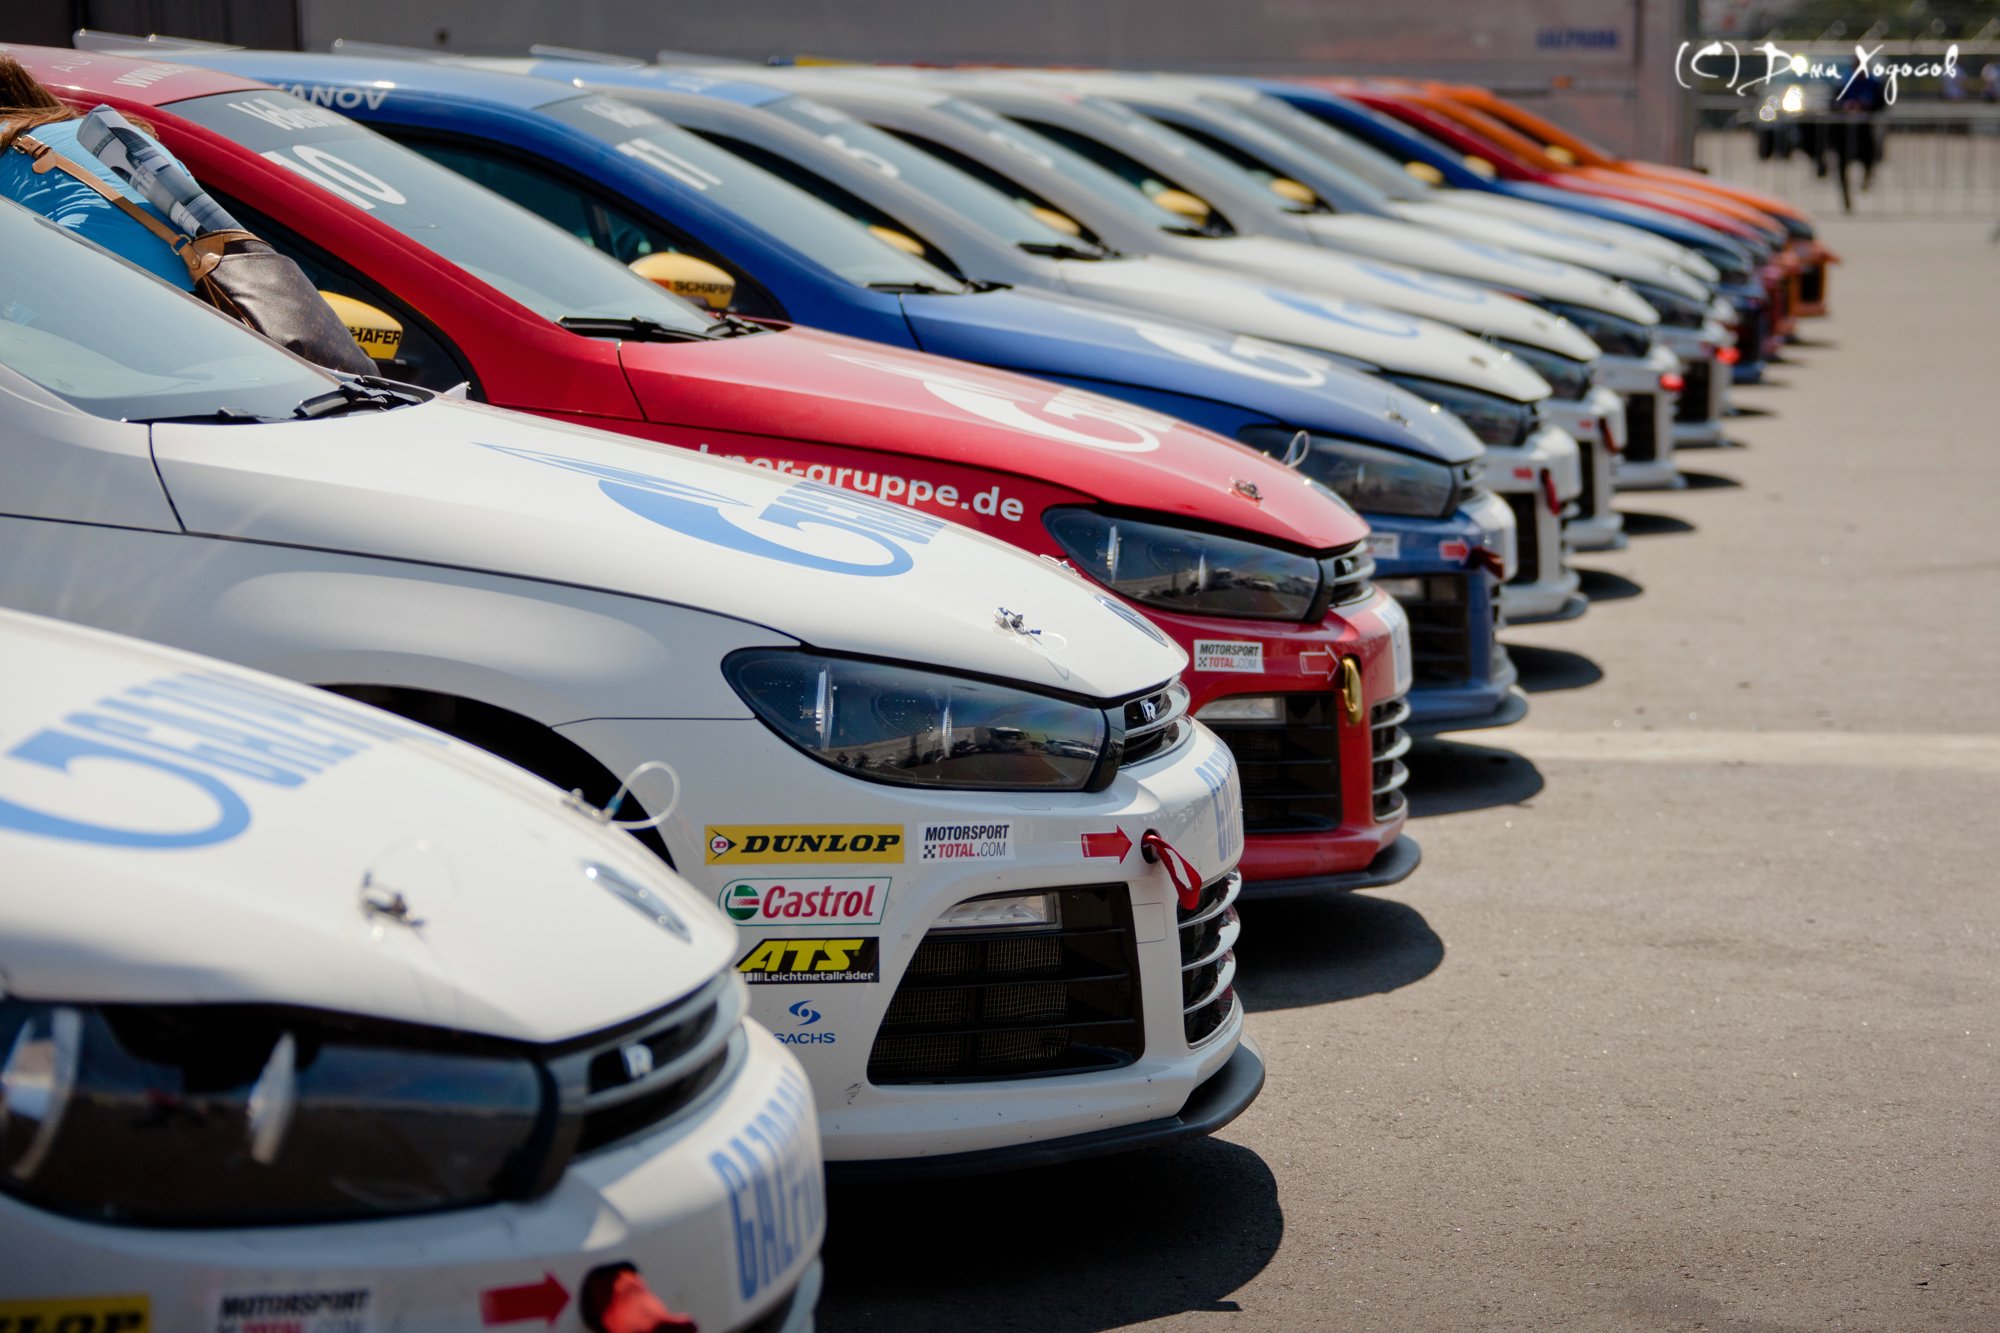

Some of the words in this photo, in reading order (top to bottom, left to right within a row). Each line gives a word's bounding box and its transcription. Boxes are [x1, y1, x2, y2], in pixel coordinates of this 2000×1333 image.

[276, 83, 388, 111] ANOV
[259, 145, 407, 210] 10
[1199, 643, 1260, 657] MOTORSPORT
[924, 824, 1010, 841] MOTORSPORT
[740, 834, 901, 853] DUNLOP
[938, 841, 1006, 858] TOTAL.COM
[762, 884, 876, 919] Castrol
[737, 938, 865, 972] ATS
[763, 970, 875, 983] Leichtmetallräder
[774, 1032, 836, 1045] SACHS
